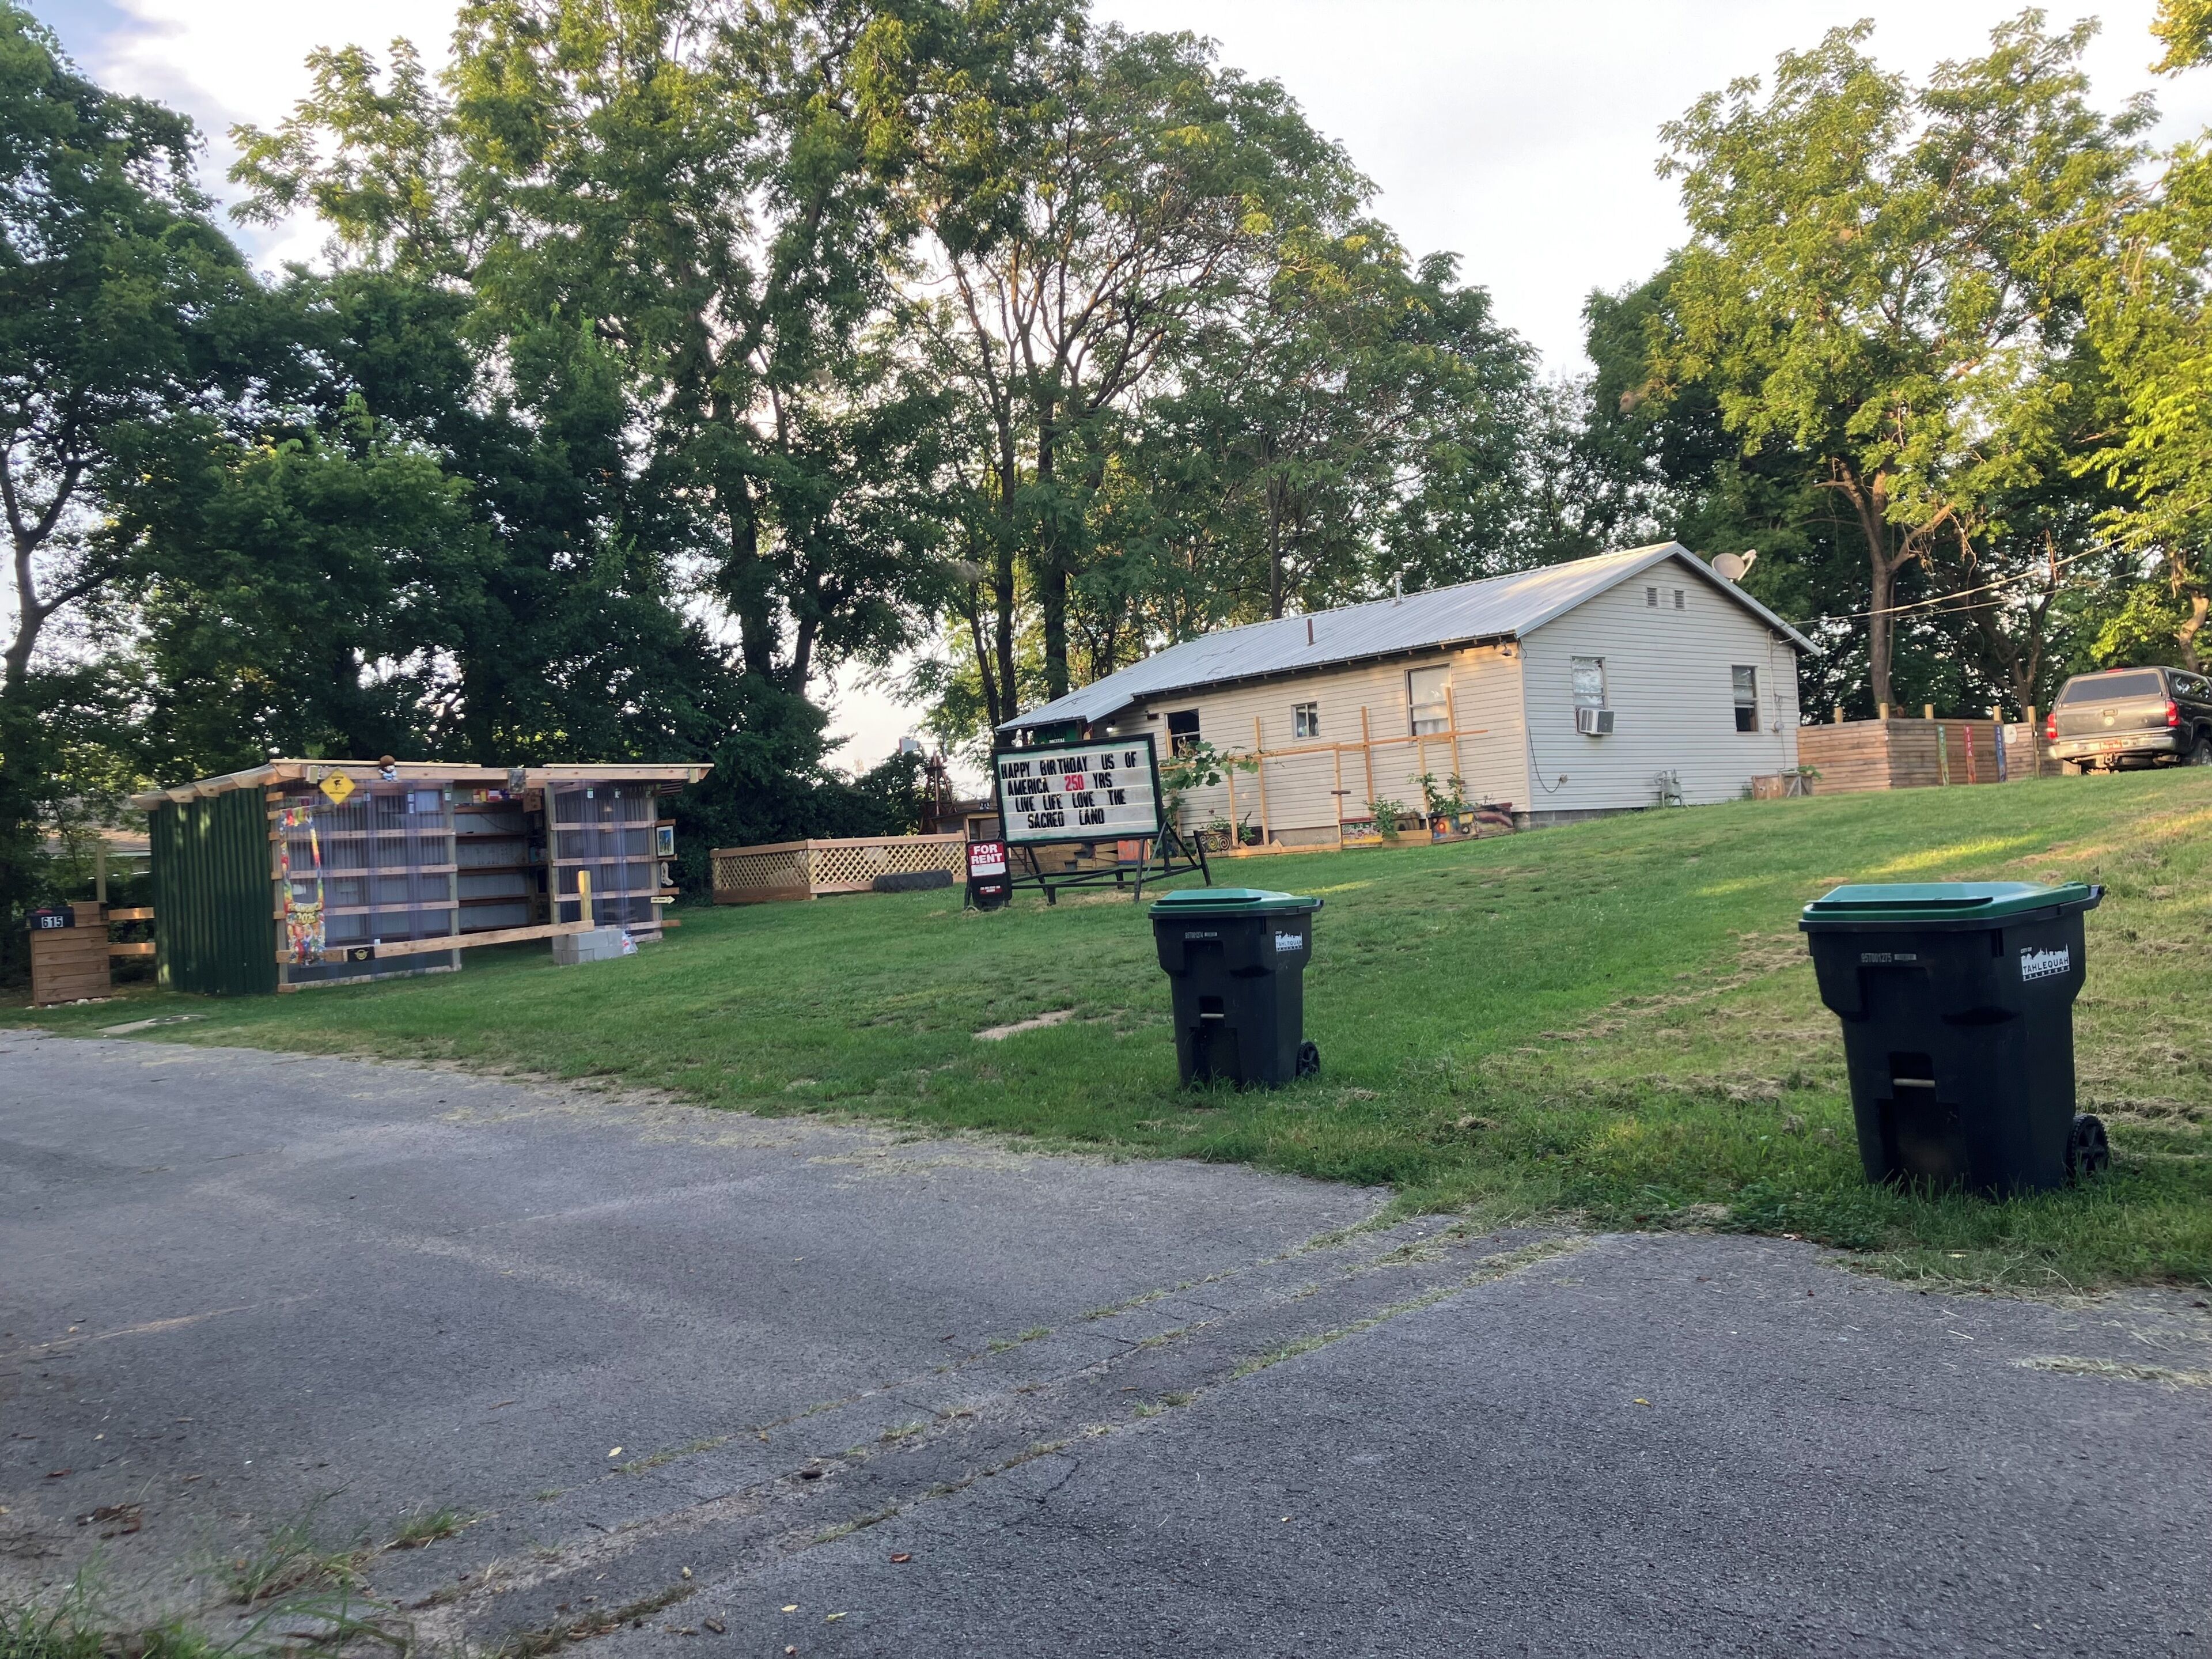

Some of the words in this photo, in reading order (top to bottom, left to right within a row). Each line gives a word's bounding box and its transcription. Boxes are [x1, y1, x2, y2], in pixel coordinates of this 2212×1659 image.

[1001, 762, 1030, 779] HAPPY
[1040, 756, 1088, 776] BIRTHDAY
[1101, 753, 1115, 770] US
[1125, 752, 1137, 768] OF
[1008, 778, 1050, 796] AMERICA
[1065, 774, 1085, 791] 250
[1093, 771, 1112, 789] YRS
[1015, 796, 1036, 812] LIVE
[1043, 794, 1063, 810] LIFE
[1072, 791, 1095, 808] LOVE
[1107, 788, 1126, 805] THE
[1028, 811, 1065, 829] SACRED
[1079, 808, 1105, 825] LAND
[971, 853, 1002, 865] RENT
[974, 844, 998, 855] FOR
[43, 917, 62, 927] 615
[2023, 957, 2069, 974] TAHLEQUAH
